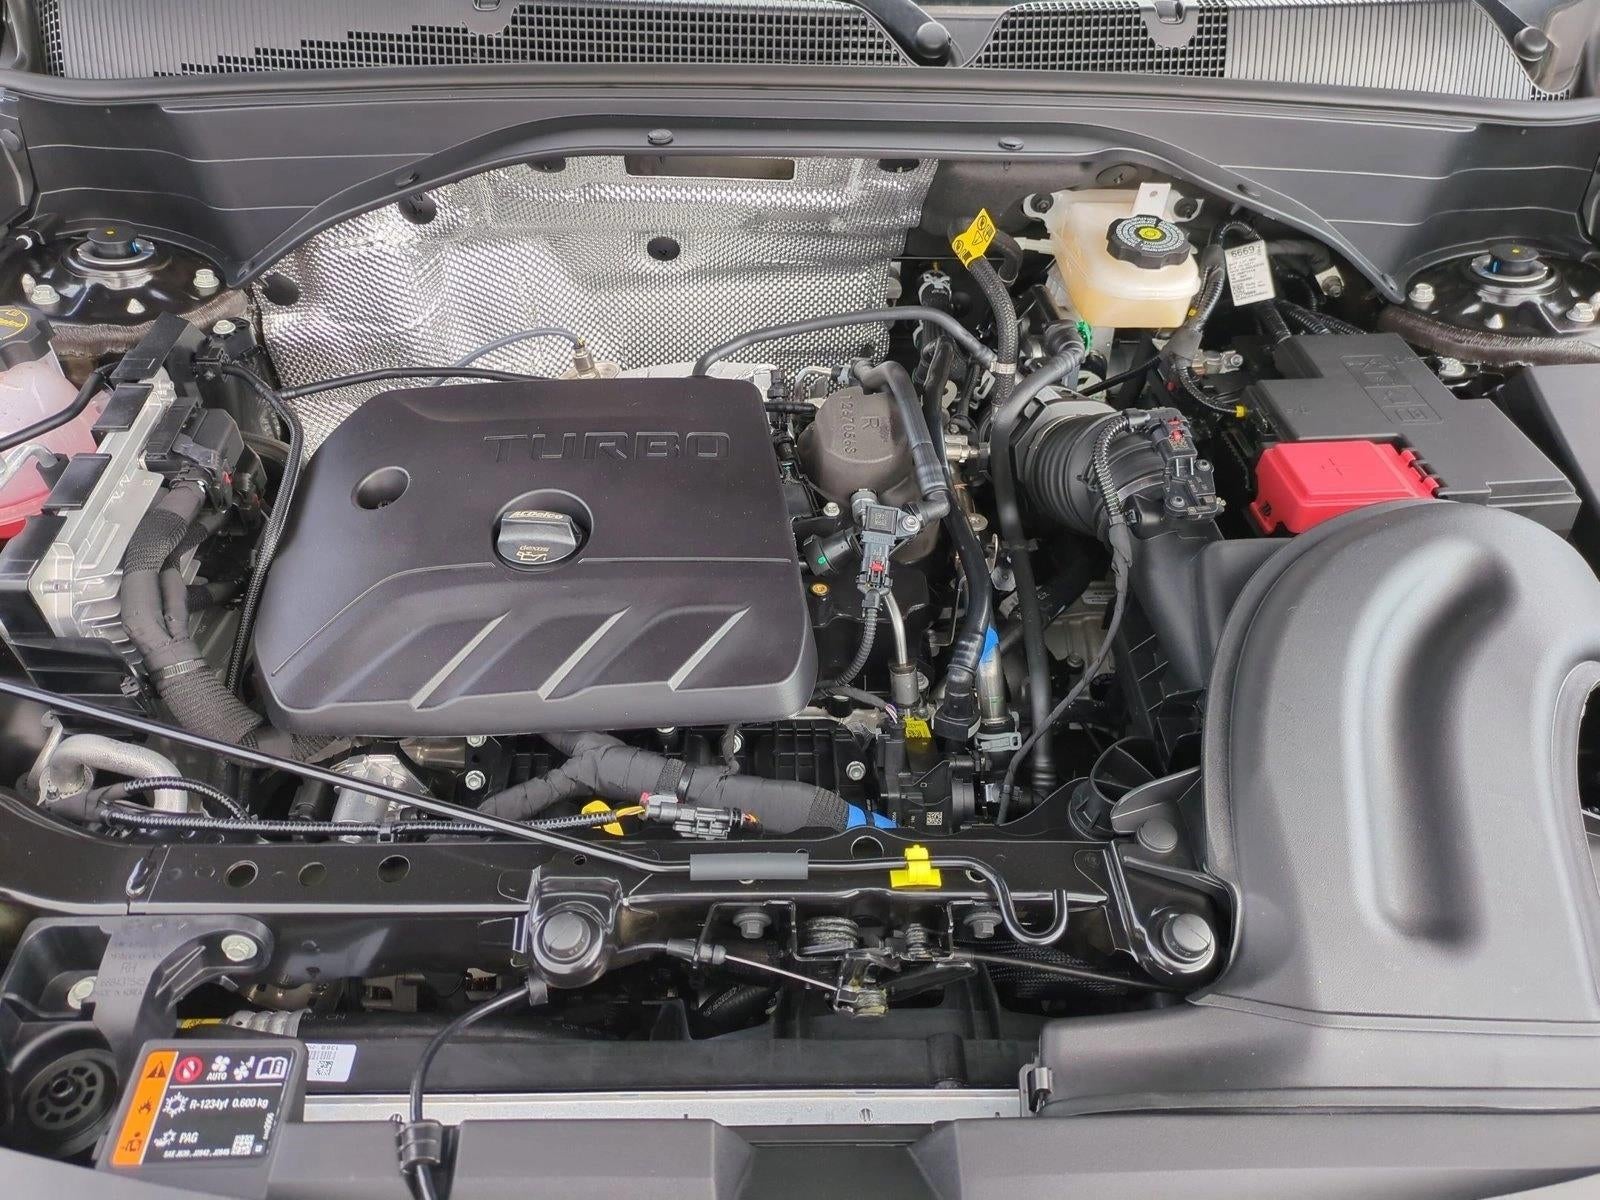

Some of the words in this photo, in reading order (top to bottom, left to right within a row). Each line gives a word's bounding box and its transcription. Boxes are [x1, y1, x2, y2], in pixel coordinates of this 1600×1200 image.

[484, 431, 731, 463] TURBO
[509, 510, 564, 519] ACDelco
[206, 1072, 228, 1081] AUTO
[189, 1098, 230, 1111] R-1234yf
[231, 1098, 257, 1109] 0.600
[257, 1096, 269, 1110] kg
[179, 1131, 199, 1144] PAG
